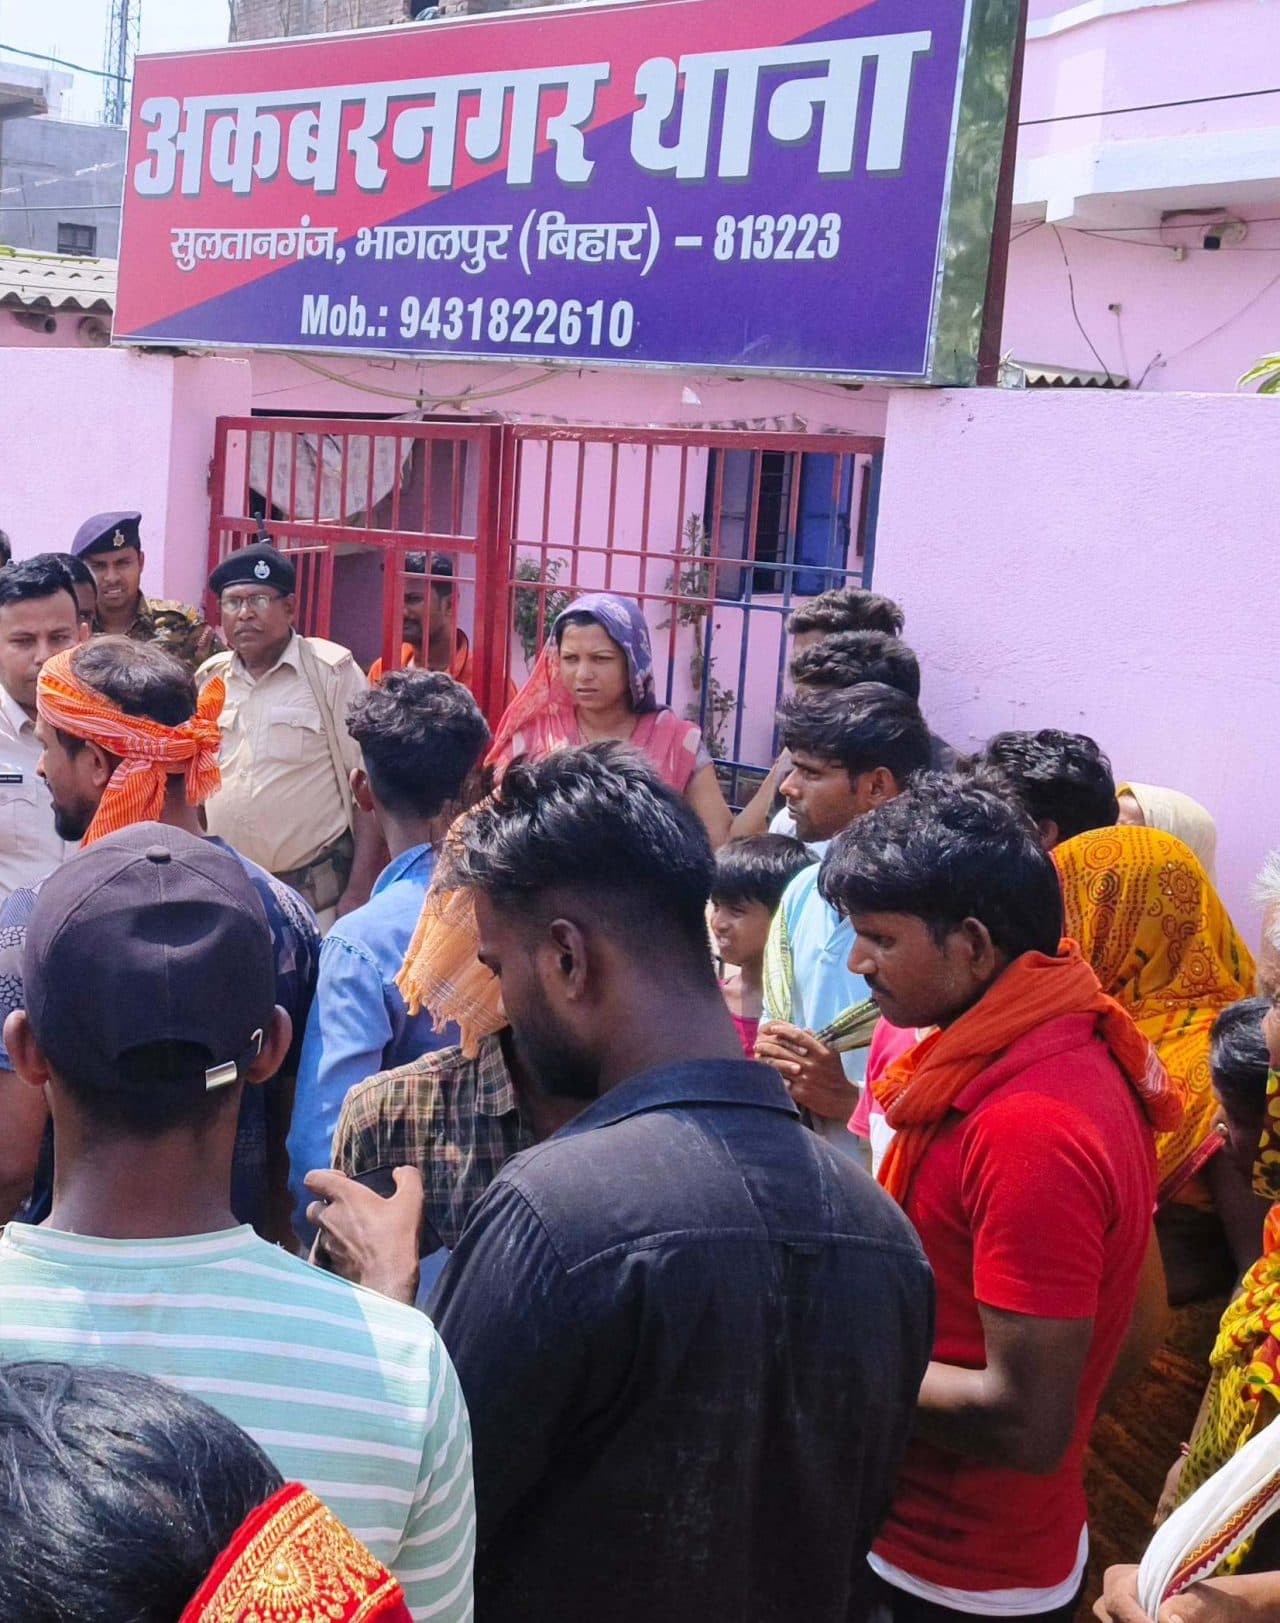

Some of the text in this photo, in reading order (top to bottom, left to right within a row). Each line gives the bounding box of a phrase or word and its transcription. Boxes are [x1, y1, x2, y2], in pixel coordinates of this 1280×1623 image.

[134, 30, 932, 196] अकबरनगर थाना
[170, 214, 346, 271] सुलतानगंज,
[355, 224, 514, 274] भागलपुर
[519, 206, 660, 276] (बिहार)
[714, 213, 841, 261] 813223
[300, 294, 634, 347] Mob.: 9431822610
